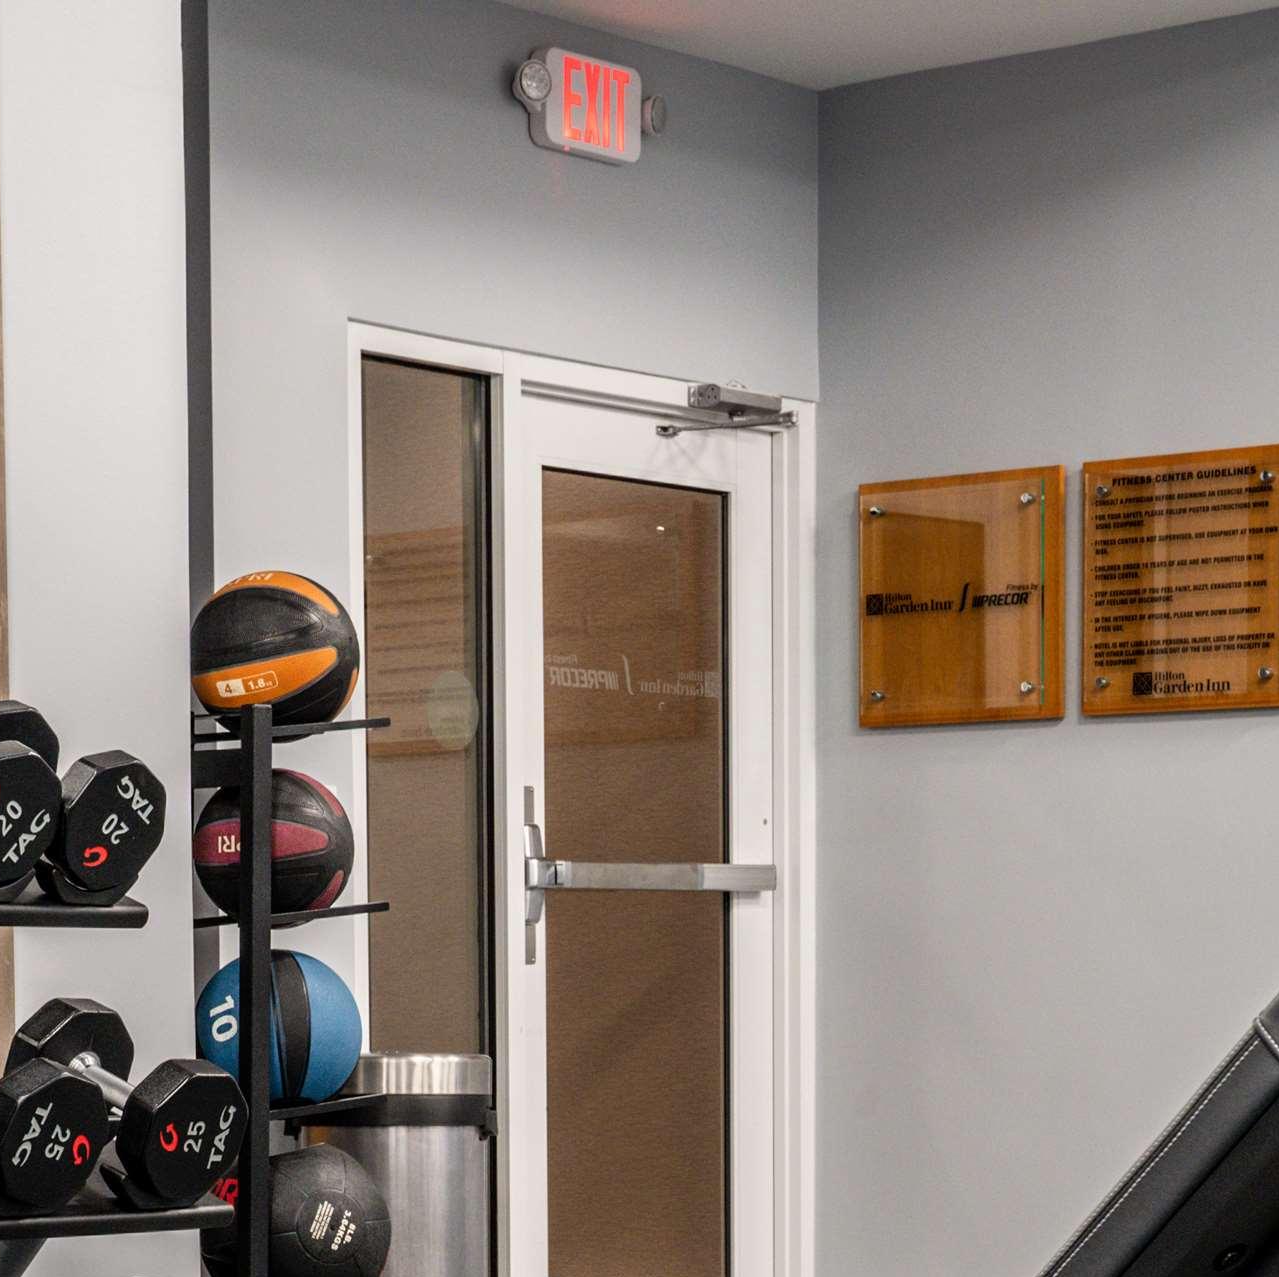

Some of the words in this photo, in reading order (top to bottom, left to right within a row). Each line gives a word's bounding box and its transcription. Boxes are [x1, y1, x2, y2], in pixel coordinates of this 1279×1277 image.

[563, 55, 630, 153] EXIT
[1112, 475, 1152, 487] FITNESS
[1155, 471, 1193, 483] CENTER
[1197, 465, 1256, 480] GUIDELINES
[884, 600, 928, 615] Garden
[931, 600, 954, 612] Inn
[981, 592, 1030, 608] PRECOR
[224, 683, 233, 695] 4
[1153, 680, 1203, 694] Garden
[1207, 679, 1231, 693] Inn
[1154, 672, 1185, 681] Hilton
[116, 775, 154, 825] TAG
[1, 808, 52, 866] TAG
[102, 814, 129, 844] 20
[210, 995, 237, 1042] 10
[11, 1102, 53, 1167] TAG
[45, 1125, 70, 1160] 25
[184, 1121, 205, 1152] 25
[207, 1106, 236, 1169] TAG
